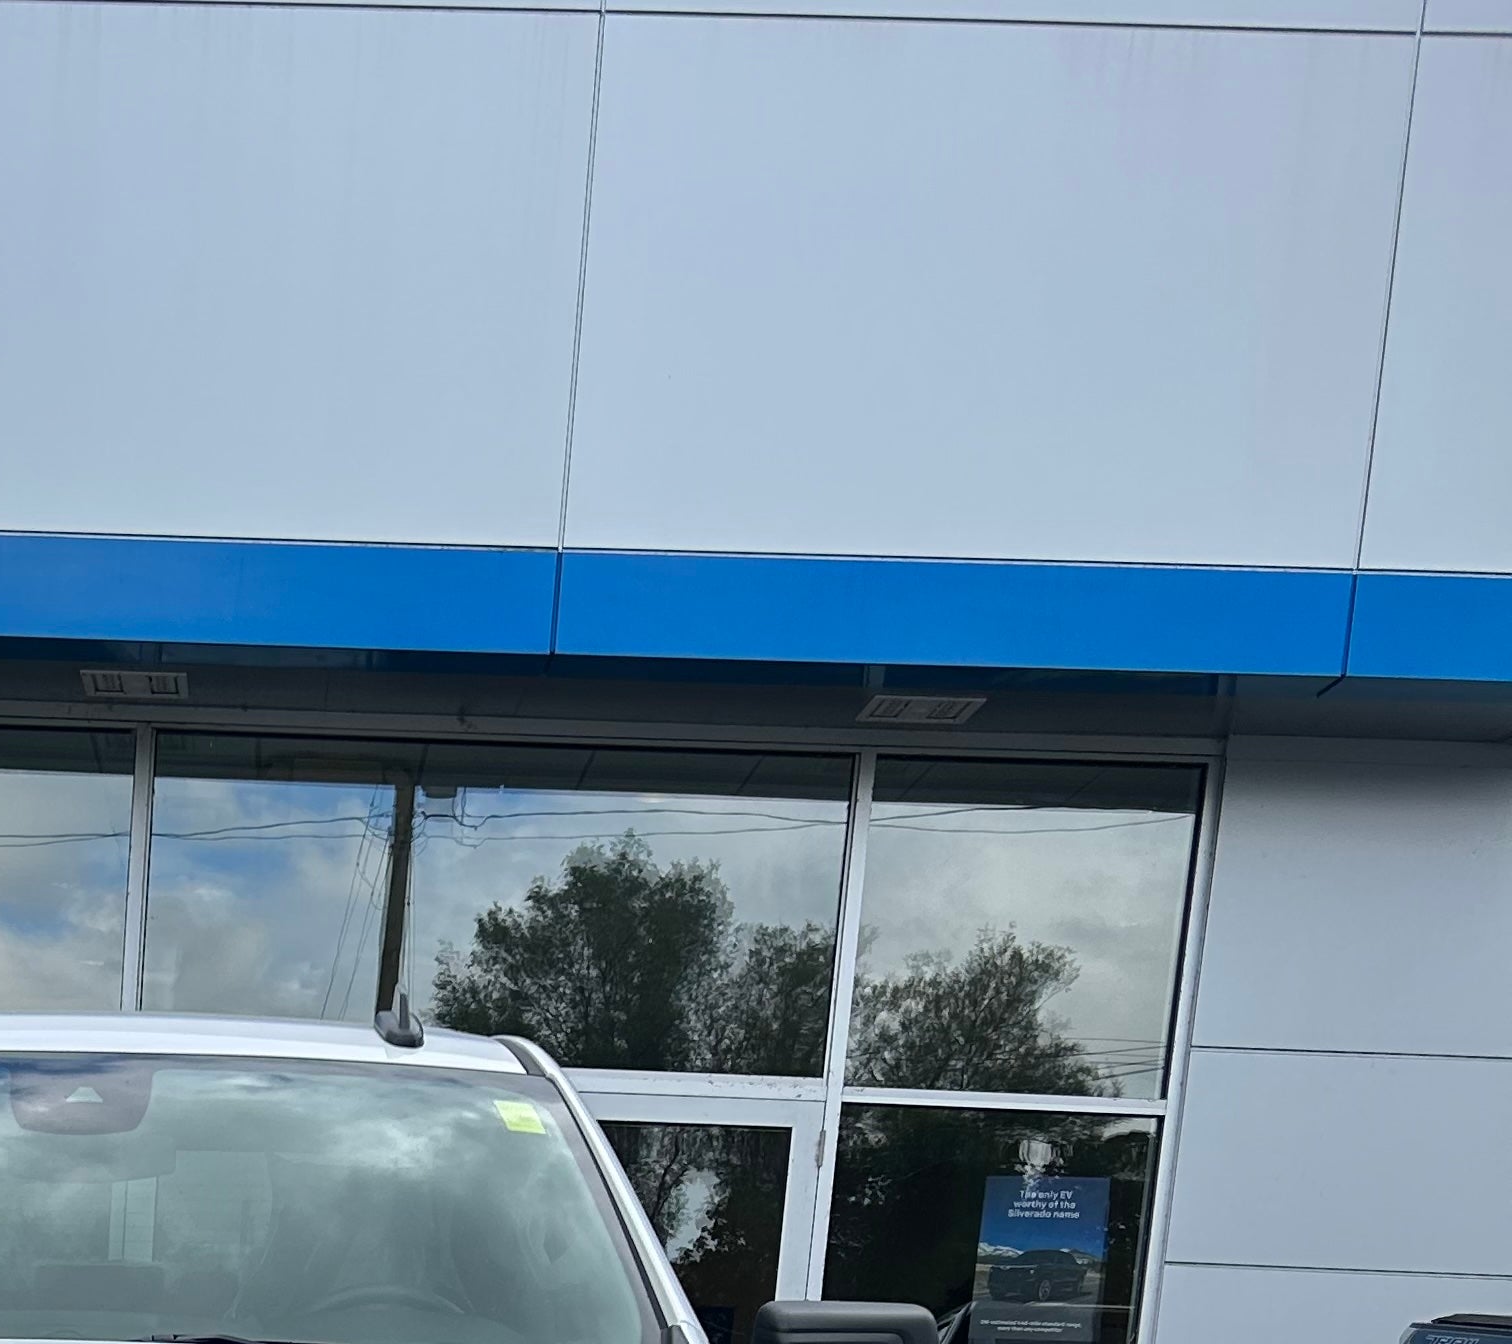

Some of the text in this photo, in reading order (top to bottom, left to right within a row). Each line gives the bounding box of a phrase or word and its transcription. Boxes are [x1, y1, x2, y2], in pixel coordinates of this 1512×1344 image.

[1038, 1190, 1058, 1200] only
[1059, 1190, 1074, 1199] EV
[1013, 1200, 1076, 1210] worthy of the
[1007, 1209, 1080, 1219] Silverado name
